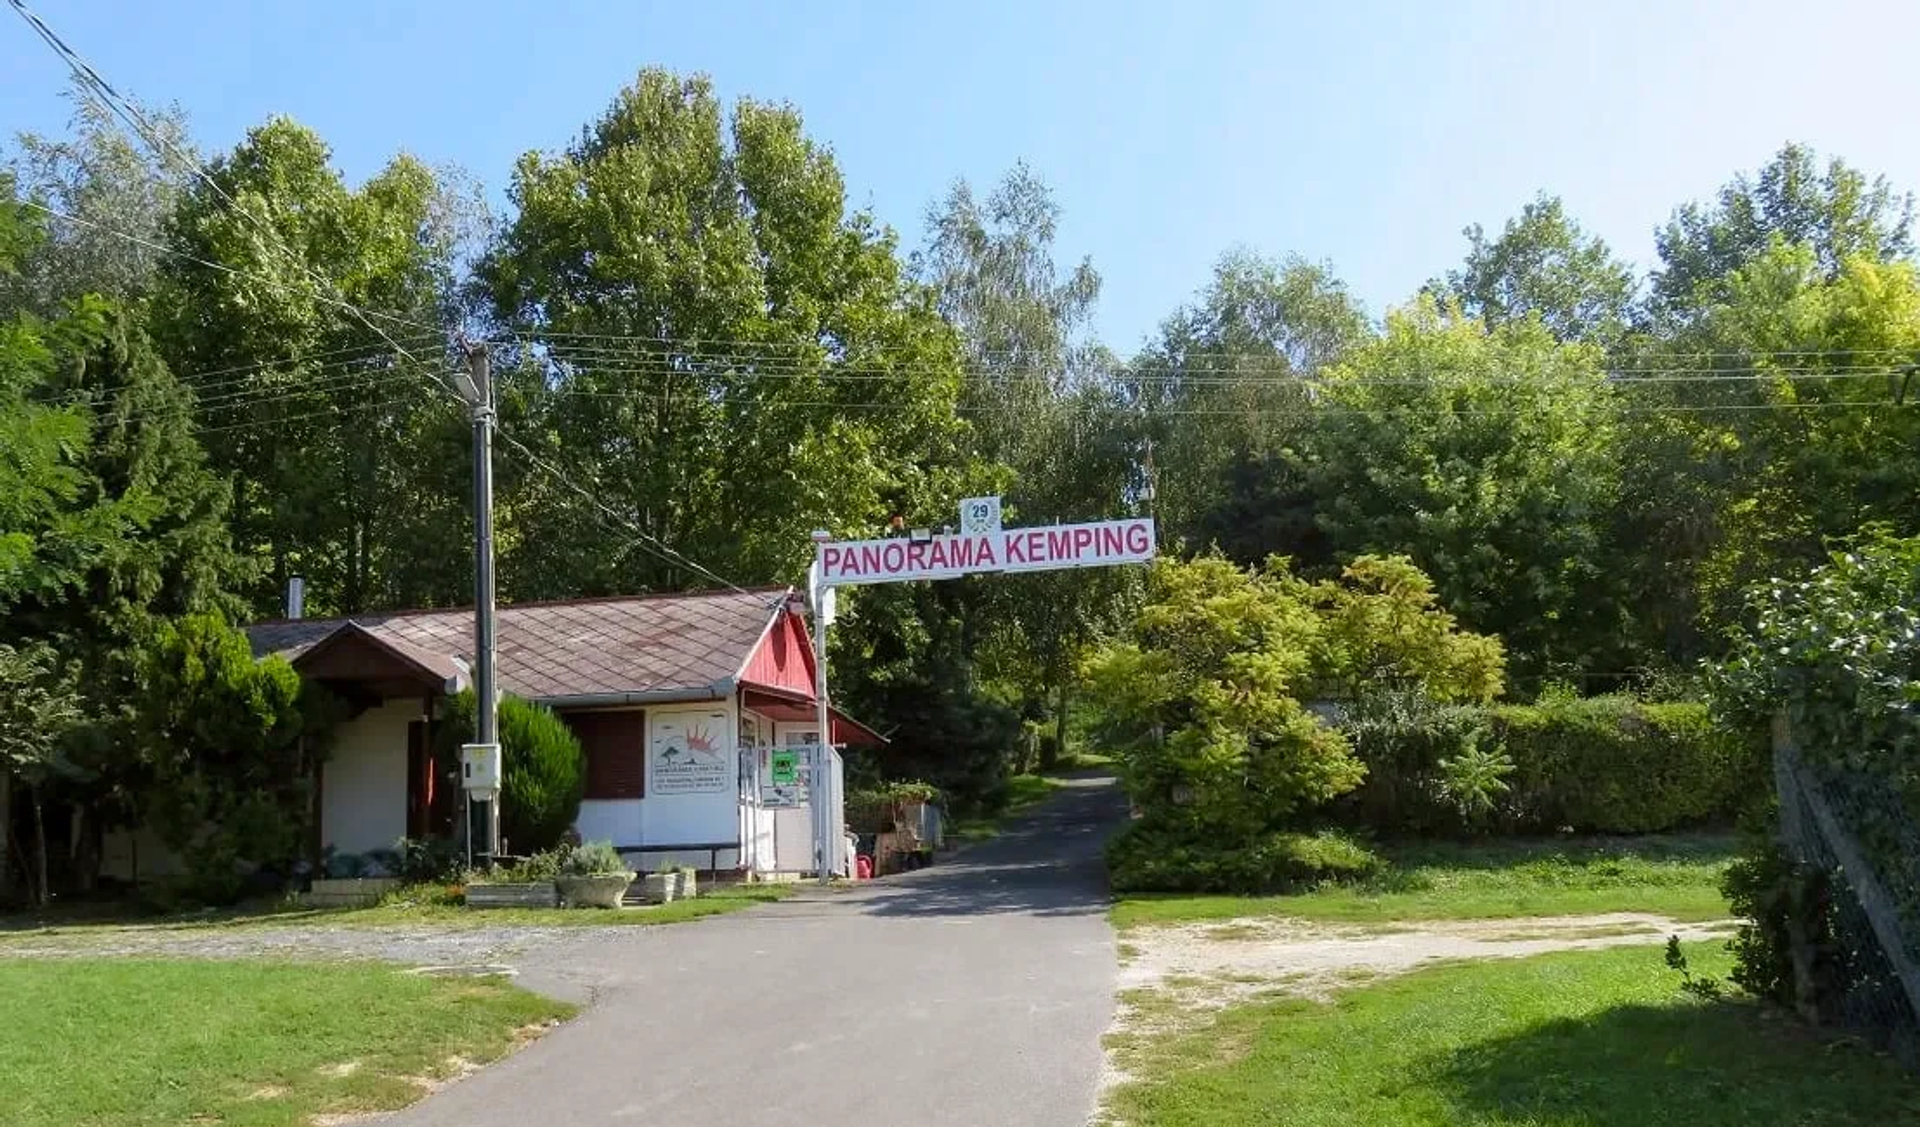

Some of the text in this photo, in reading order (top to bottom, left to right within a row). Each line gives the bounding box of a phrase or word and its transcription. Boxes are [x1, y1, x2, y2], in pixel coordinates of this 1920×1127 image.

[972, 504, 988, 518] 29
[823, 523, 1149, 577] PANORAMA KEMPING
